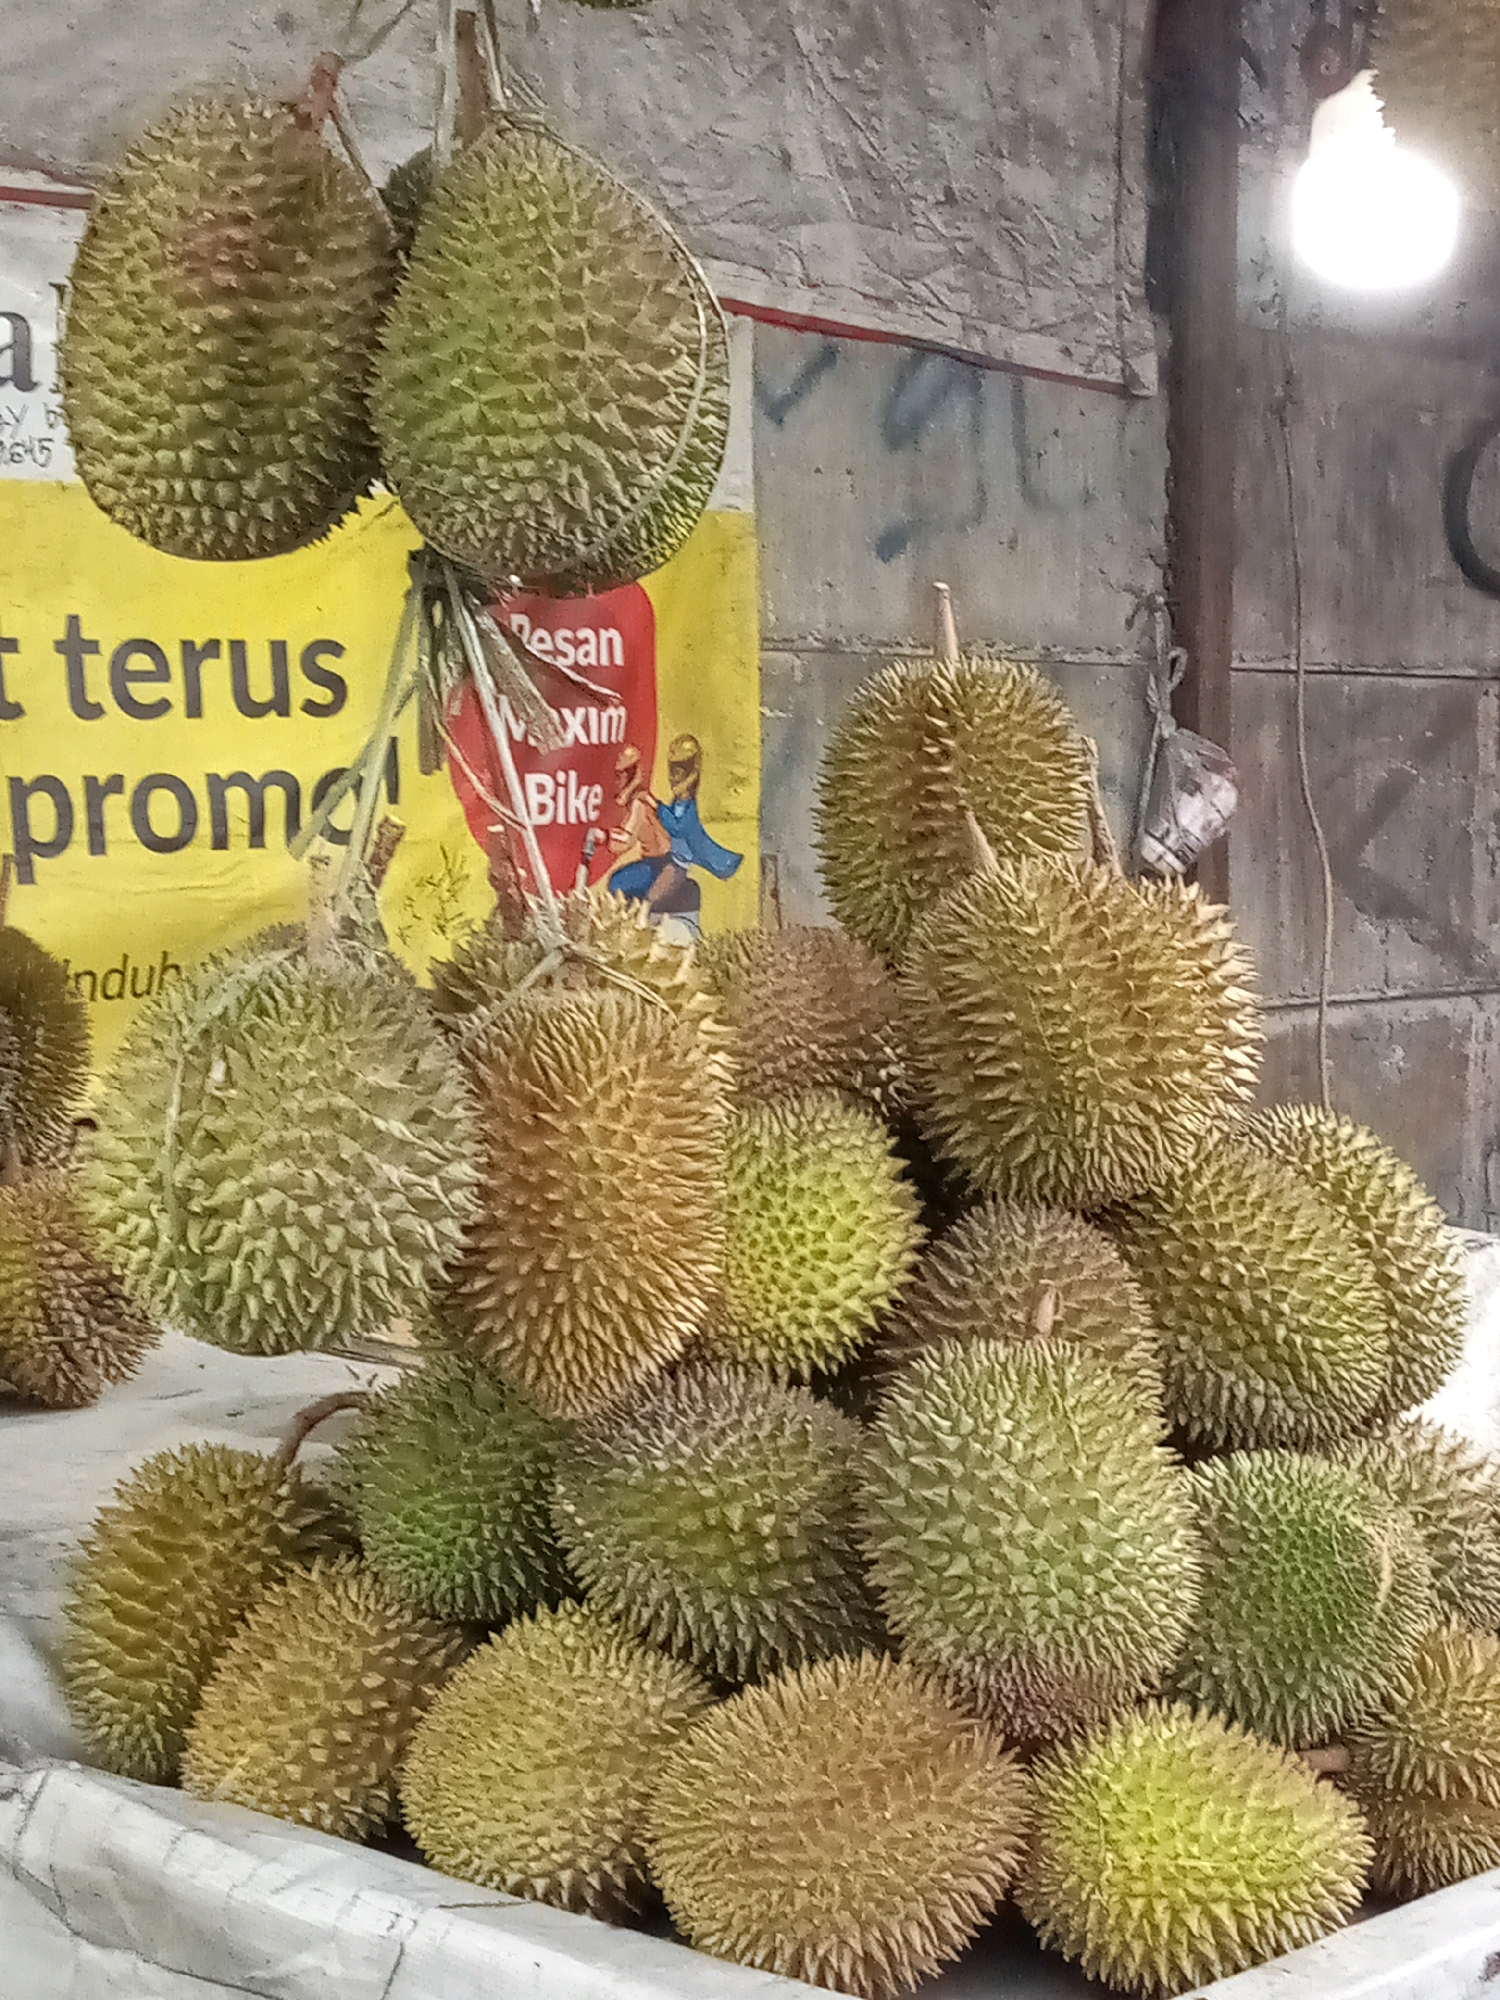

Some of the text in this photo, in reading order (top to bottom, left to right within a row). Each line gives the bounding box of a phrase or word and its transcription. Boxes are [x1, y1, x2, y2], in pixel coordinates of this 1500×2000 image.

[54, 614, 349, 721] terus
[524, 770, 604, 826] Bike
[63, 950, 182, 1002] nduh
